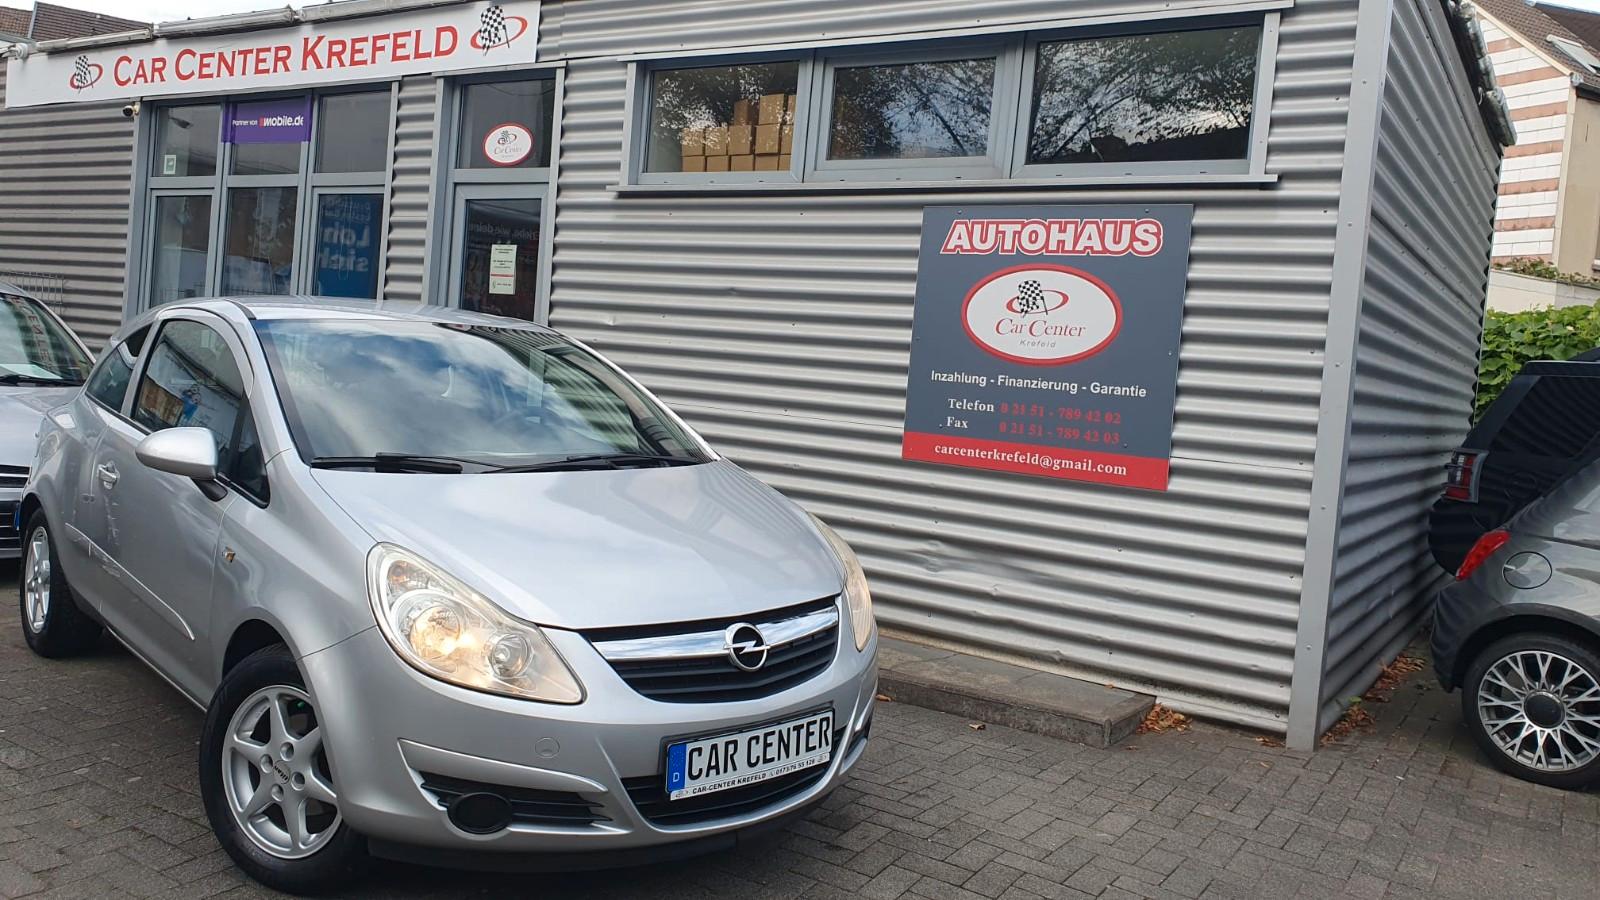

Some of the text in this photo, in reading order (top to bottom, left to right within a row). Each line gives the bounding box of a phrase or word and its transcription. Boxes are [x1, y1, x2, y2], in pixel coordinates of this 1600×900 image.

[114, 25, 458, 87] CAR CENTER KREFELD
[940, 218, 1164, 257] AUTOHAUS
[995, 318, 1087, 338] Car Center
[1019, 339, 1057, 349] Krefeld
[931, 370, 988, 387] Inzahlung
[997, 375, 1079, 395] Finanzierung
[1090, 381, 1147, 398] Garantie
[948, 399, 995, 413] Telefon
[1058, 407, 1082, 420] 789
[1105, 412, 1121, 424] 02
[946, 415, 969, 429] Fax
[1056, 427, 1080, 440] 789
[934, 443, 1128, 477] carcenterkrefeld@gmail.com
[687, 716, 831, 781] CAR CENTER
[672, 771, 680, 783] D
[692, 779, 736, 795] CAR-CENTER
[737, 773, 767, 785] KREFELD
